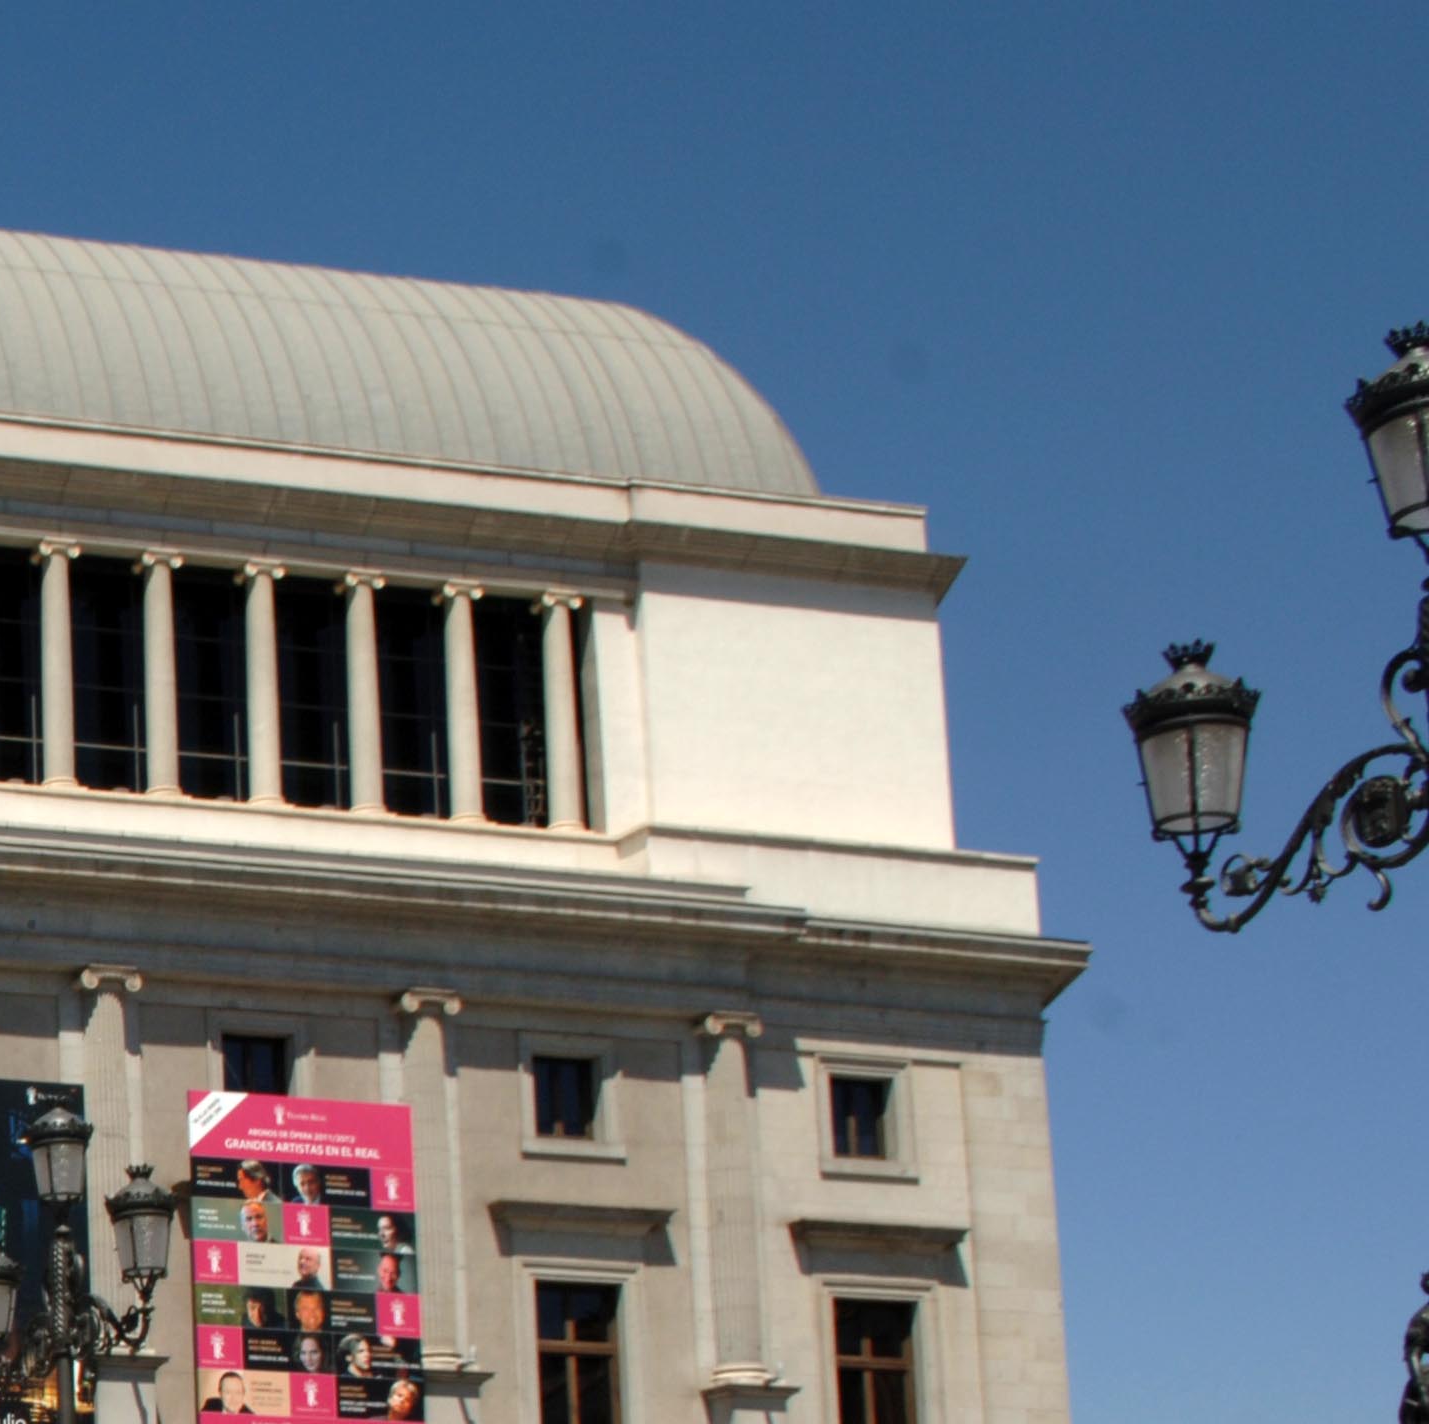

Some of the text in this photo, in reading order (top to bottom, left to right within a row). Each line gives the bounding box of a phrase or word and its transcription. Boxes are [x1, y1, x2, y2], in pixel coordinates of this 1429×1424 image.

[248, 1128, 277, 1137] ABONOS
[224, 1138, 381, 1159] GRANDES ARTISTAS EN EL REAL
